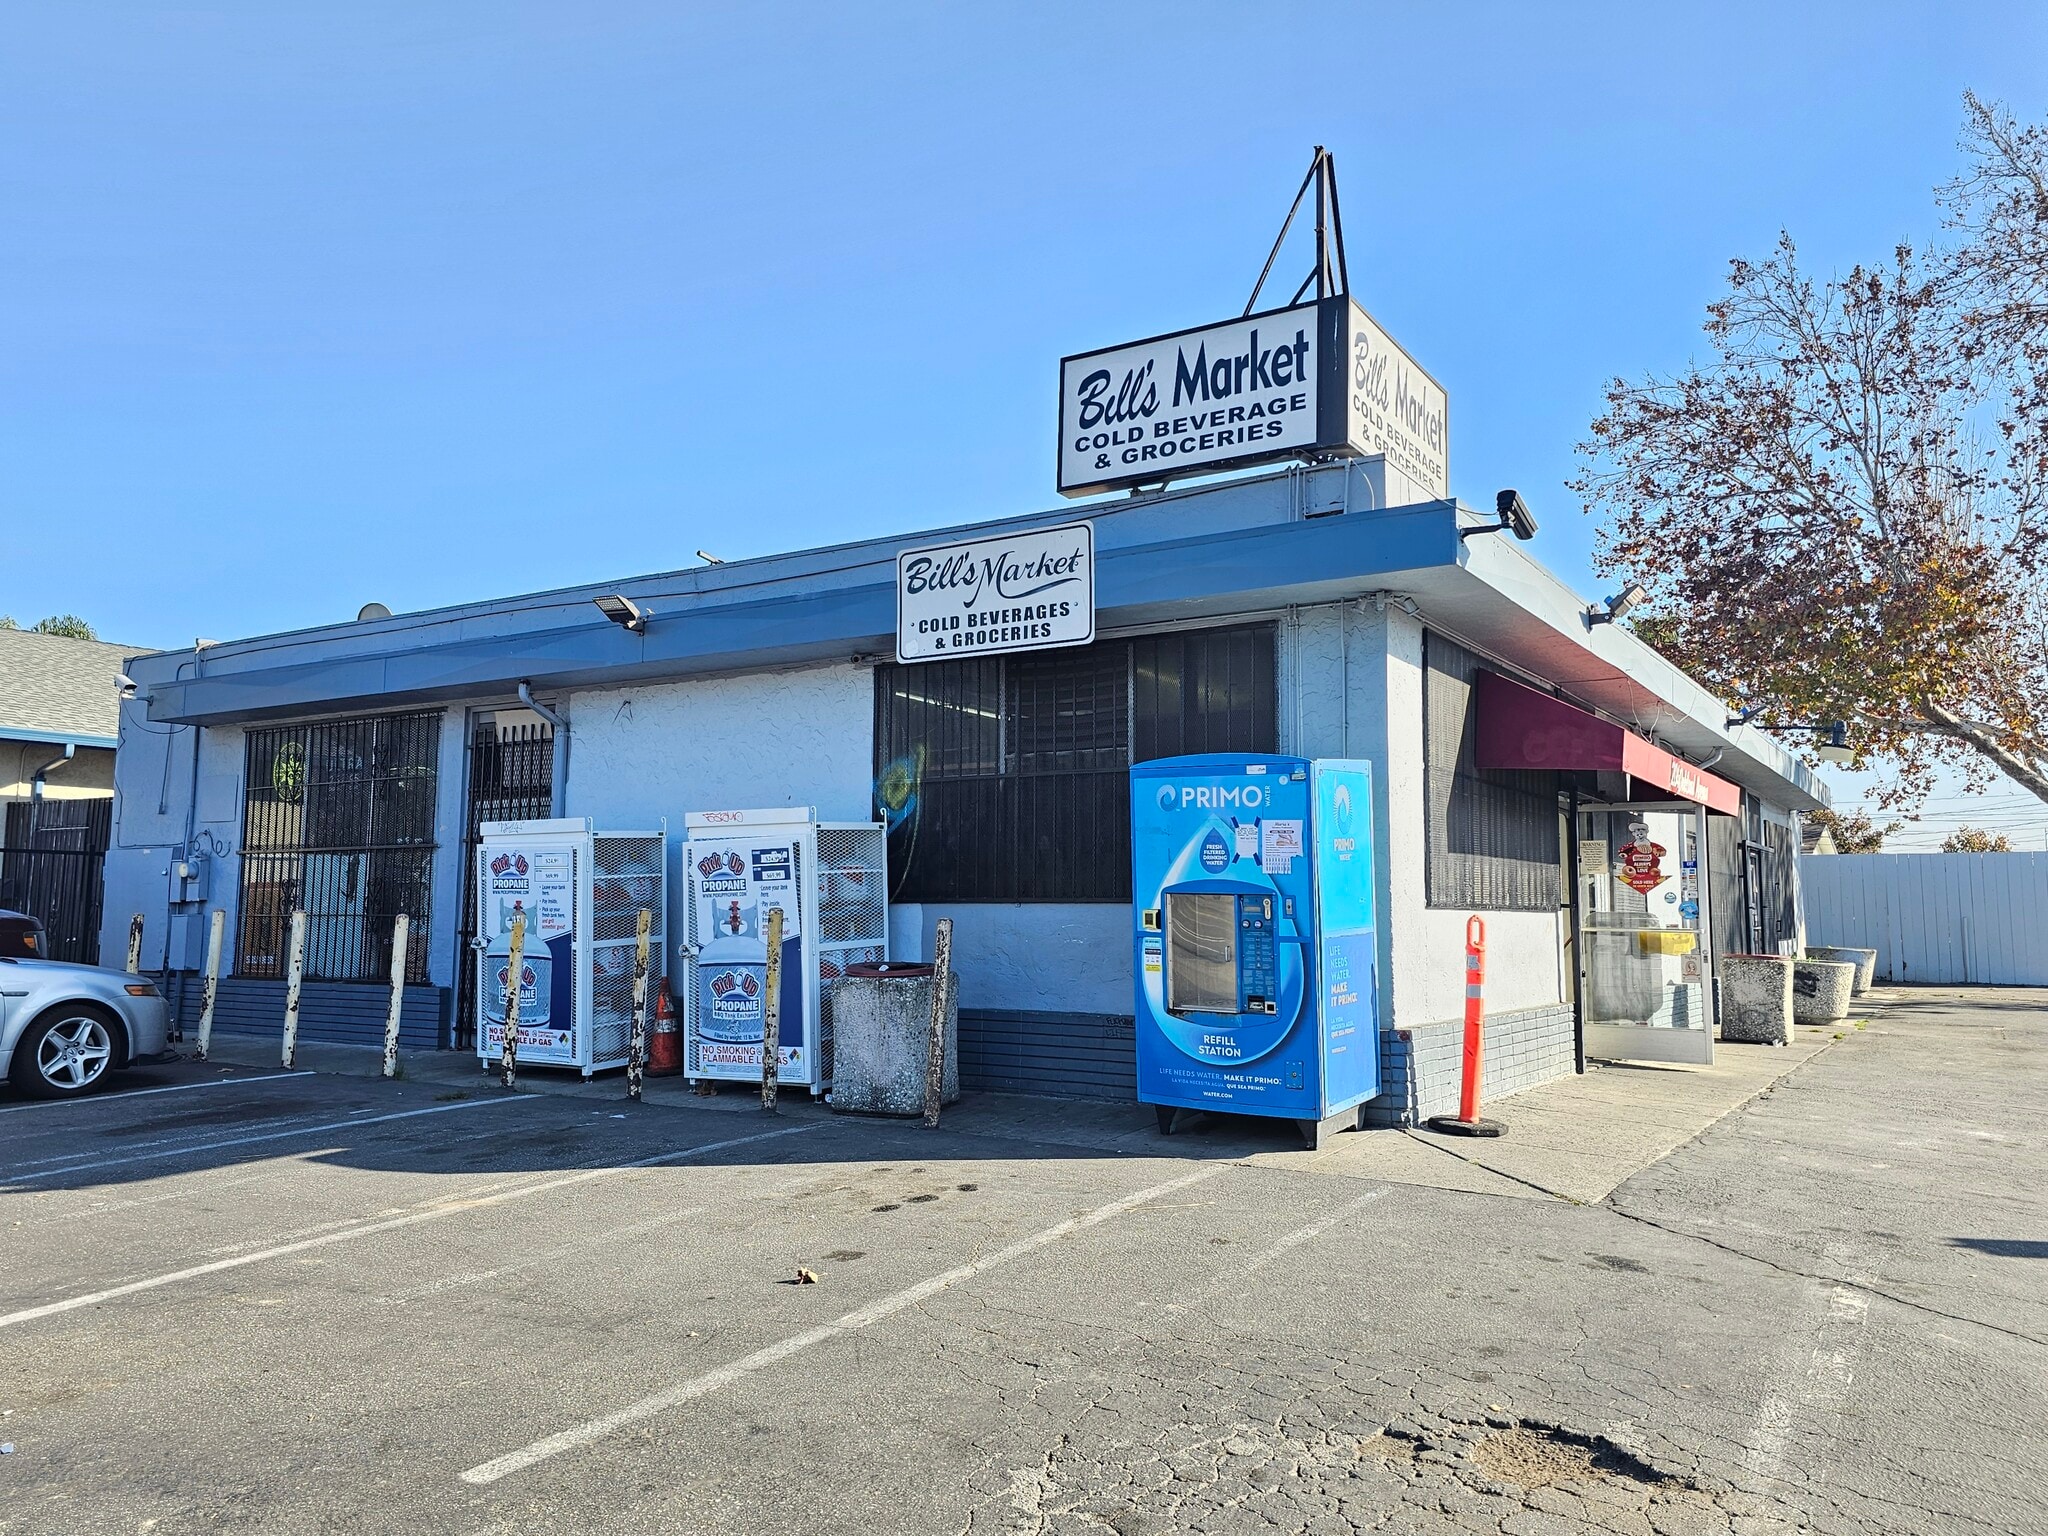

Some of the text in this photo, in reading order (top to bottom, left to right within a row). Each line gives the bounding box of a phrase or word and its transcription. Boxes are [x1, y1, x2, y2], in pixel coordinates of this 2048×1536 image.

[1077, 328, 1310, 430] Bill's Market
[1354, 331, 1443, 457] Bill's Market
[1074, 392, 1307, 452] COLD BEVERAGE
[1353, 394, 1443, 480] COLD BEVERAGE
[1363, 424, 1371, 443] &
[1094, 420, 1284, 470] & GROCERIES
[905, 547, 1085, 608] Bill's Market
[919, 601, 1071, 634] COLD BEVERAGES
[935, 622, 1052, 650] & GROCERIES
[1181, 785, 1263, 809] PRIMO
[698, 852, 746, 879] Pick Up
[493, 879, 530, 889] PROPANE
[702, 880, 747, 892] PROPANE
[501, 988, 536, 999] PANE
[712, 973, 760, 998] Pick Up
[715, 1000, 759, 1011] PROPANE
[489, 1027, 499, 1035] NO
[499, 1028, 530, 1037] SING
[1203, 1034, 1236, 1046] REFILL
[702, 1046, 756, 1055] NO SMOKING
[702, 1054, 789, 1066] FLAMMABLE L AS
[1198, 1045, 1241, 1058] STATION
[1159, 1067, 1172, 1075] LIFE
[1173, 1069, 1196, 1077] NEEDS
[1223, 1074, 1244, 1082] MAKE
[1203, 1091, 1233, 1099] WATER.COM
